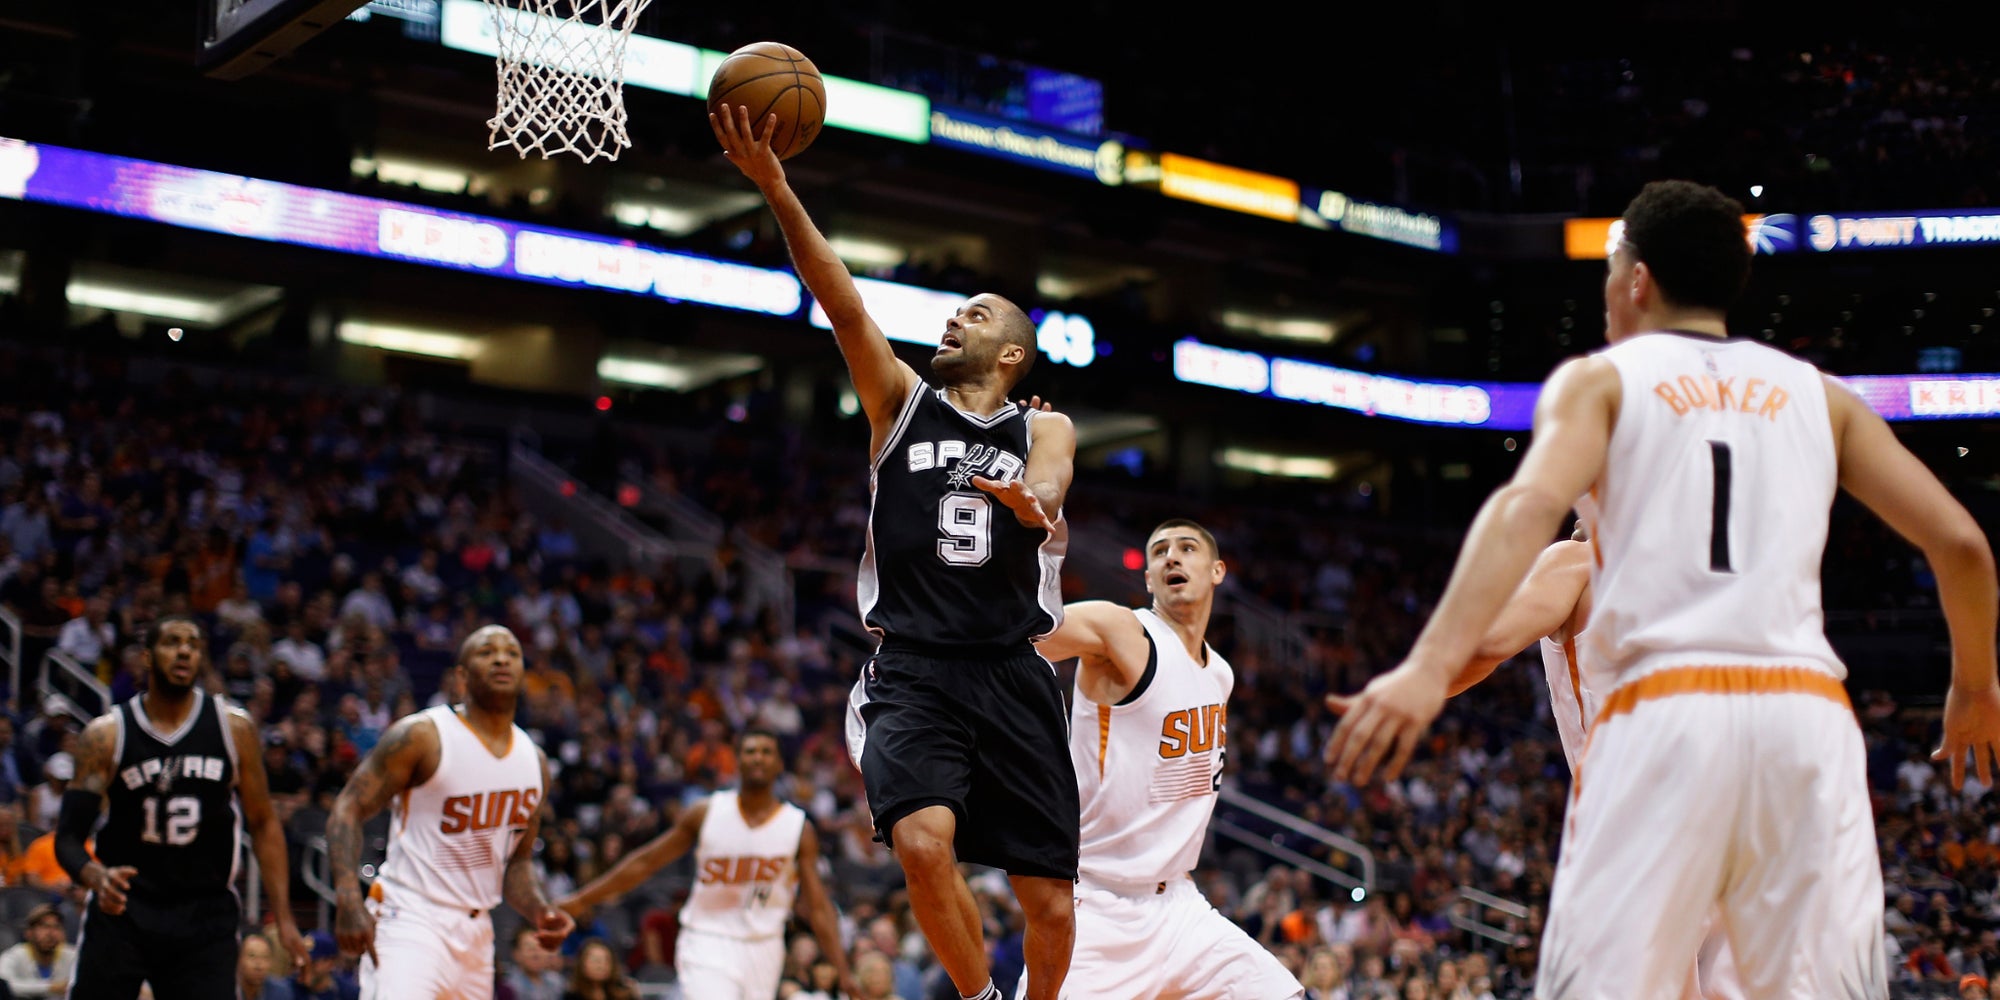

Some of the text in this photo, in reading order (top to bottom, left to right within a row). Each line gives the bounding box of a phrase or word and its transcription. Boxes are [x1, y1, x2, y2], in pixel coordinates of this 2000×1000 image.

[1810, 214, 1837, 251] 3
[1838, 217, 1918, 246] POINT
[908, 439, 1025, 486] SPUR
[937, 491, 992, 567] 9
[1705, 439, 1739, 574] 1
[120, 754, 225, 791] SPURS
[141, 796, 201, 846] 12
[440, 788, 538, 834] SUNS
[700, 856, 787, 885] SUNS
